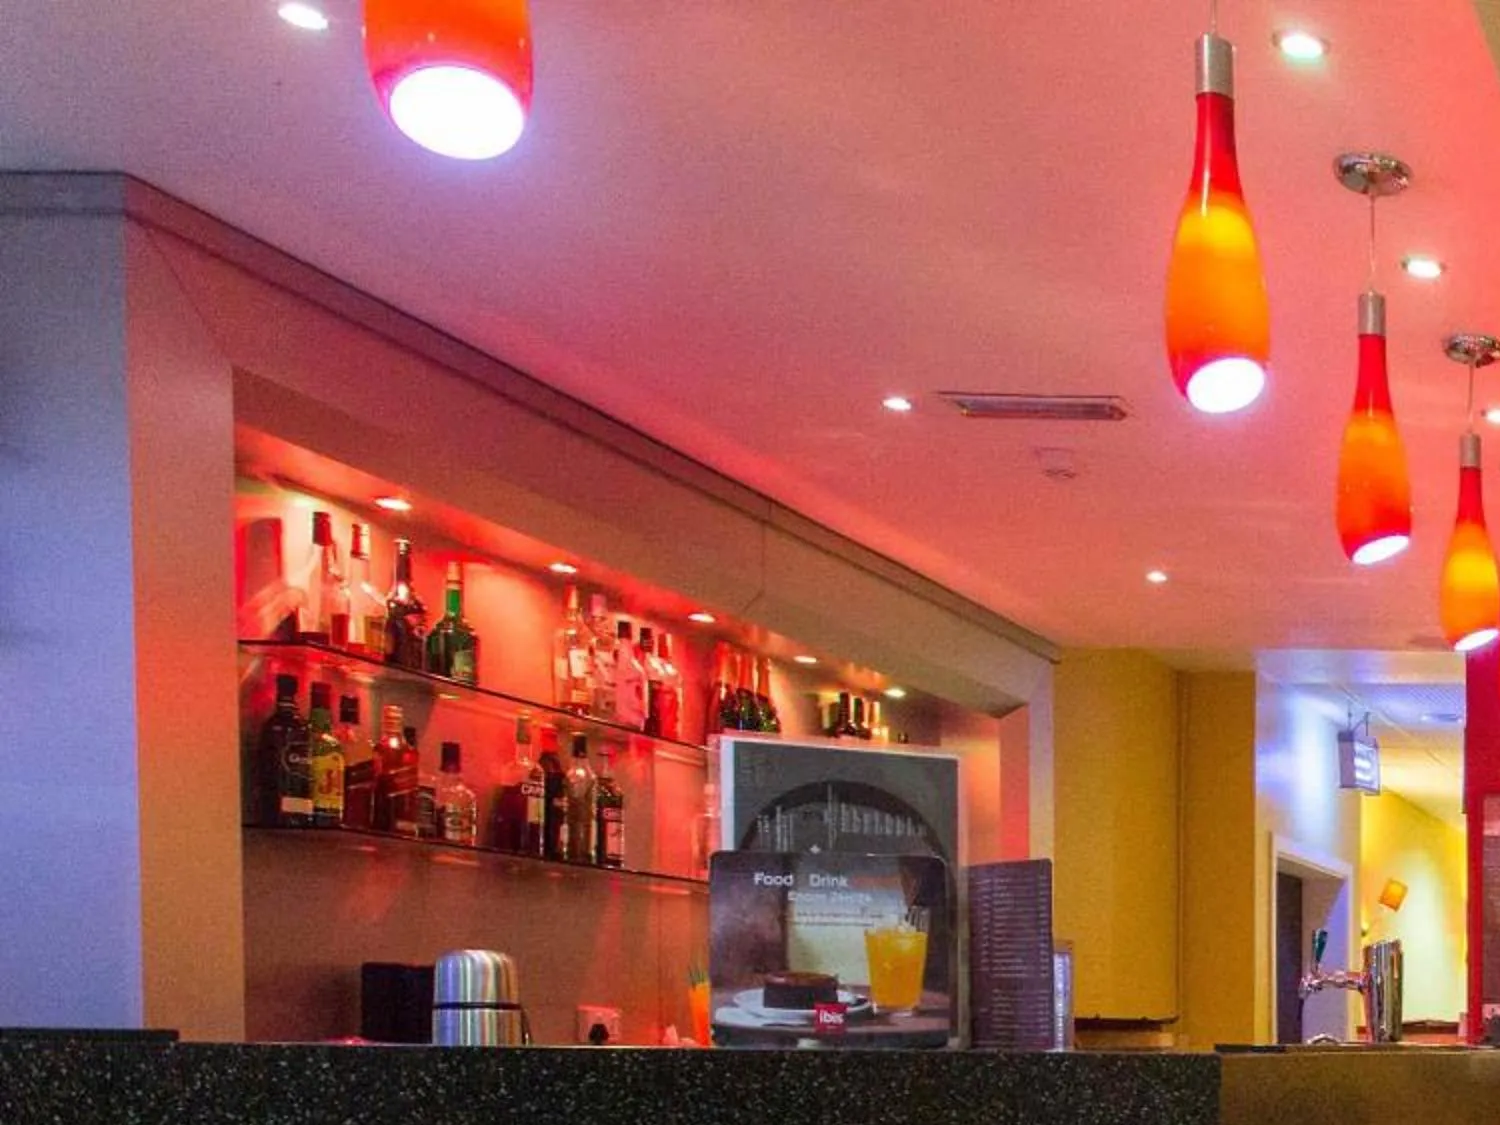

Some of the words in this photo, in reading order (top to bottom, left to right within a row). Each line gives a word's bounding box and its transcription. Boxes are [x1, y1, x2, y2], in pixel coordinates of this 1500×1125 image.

[753, 872, 794, 887] Food
[809, 873, 849, 887] Drink
[819, 1010, 844, 1025] ibis
